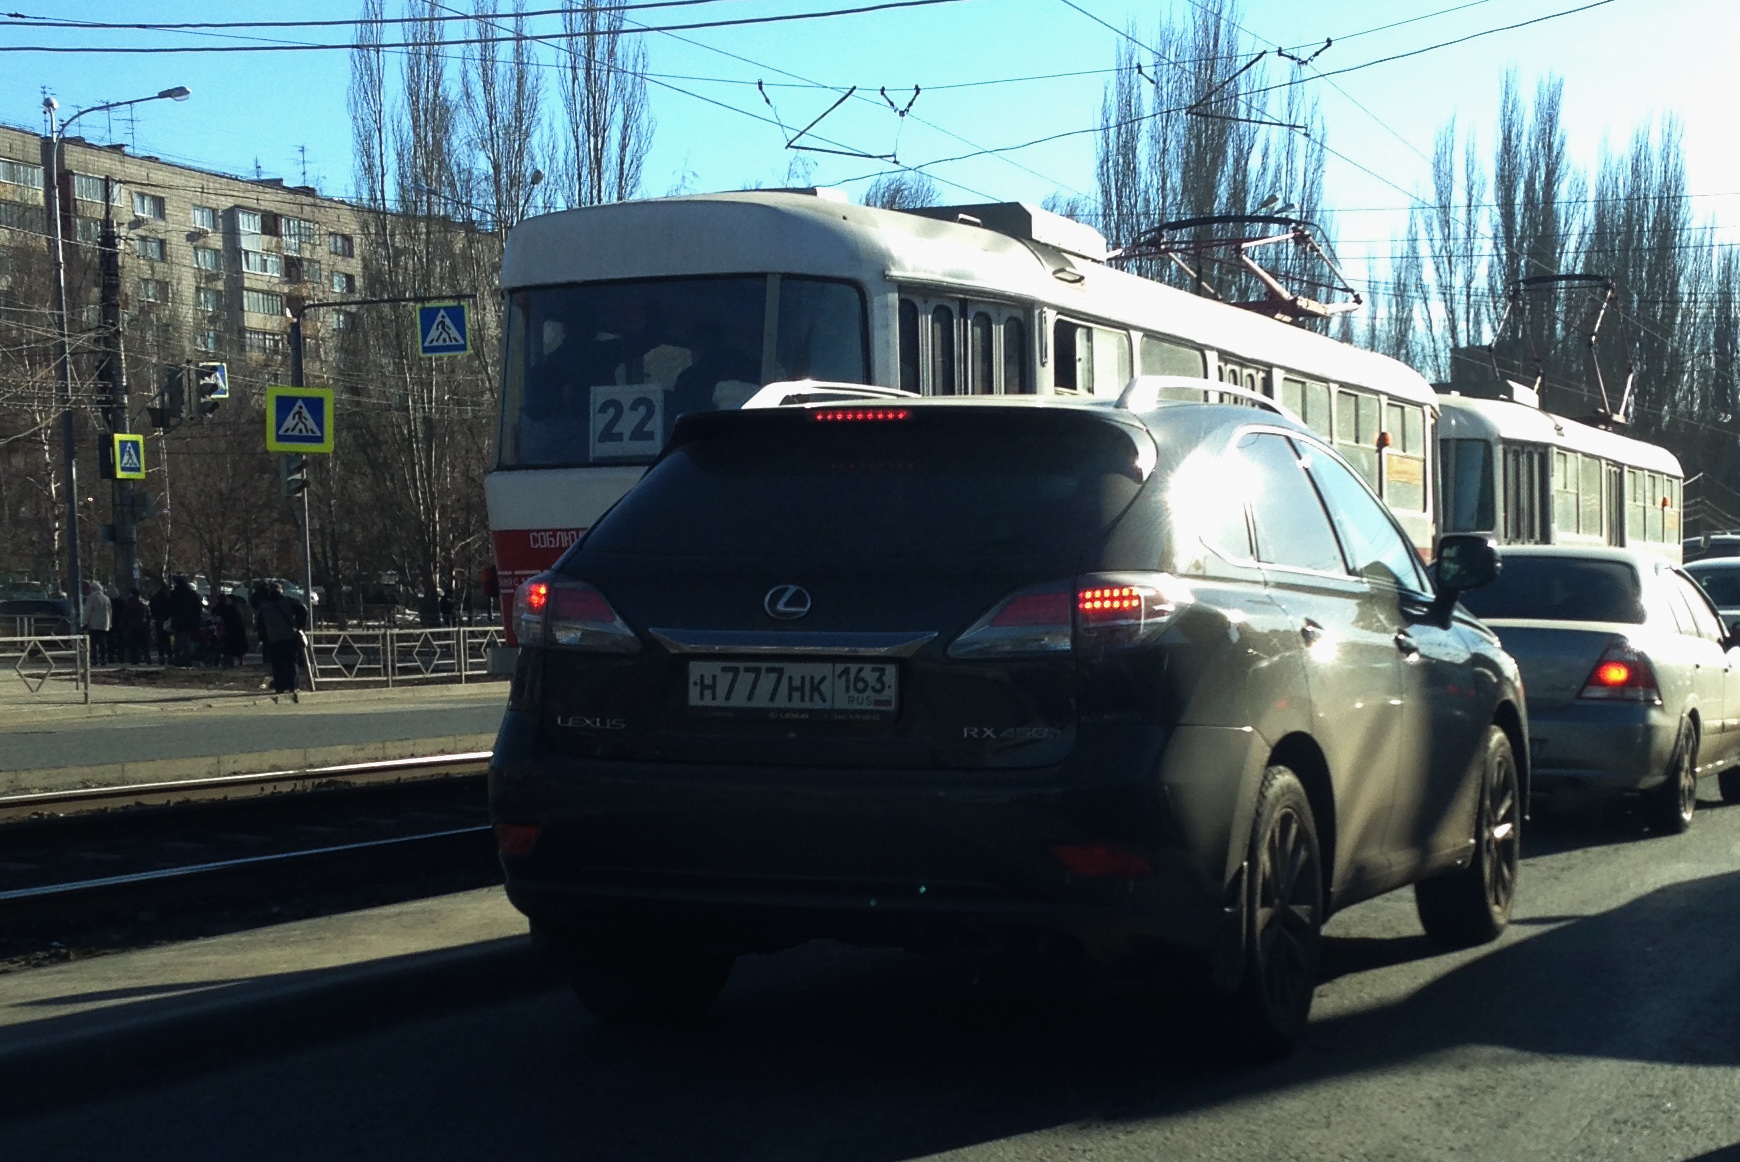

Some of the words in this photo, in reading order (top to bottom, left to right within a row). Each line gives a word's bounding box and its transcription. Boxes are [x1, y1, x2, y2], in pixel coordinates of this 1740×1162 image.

[597, 397, 656, 443] 22
[837, 666, 887, 695] 163
[847, 695, 873, 706] RUS
[556, 715, 626, 730] LEXUS
[962, 726, 998, 739] RX
